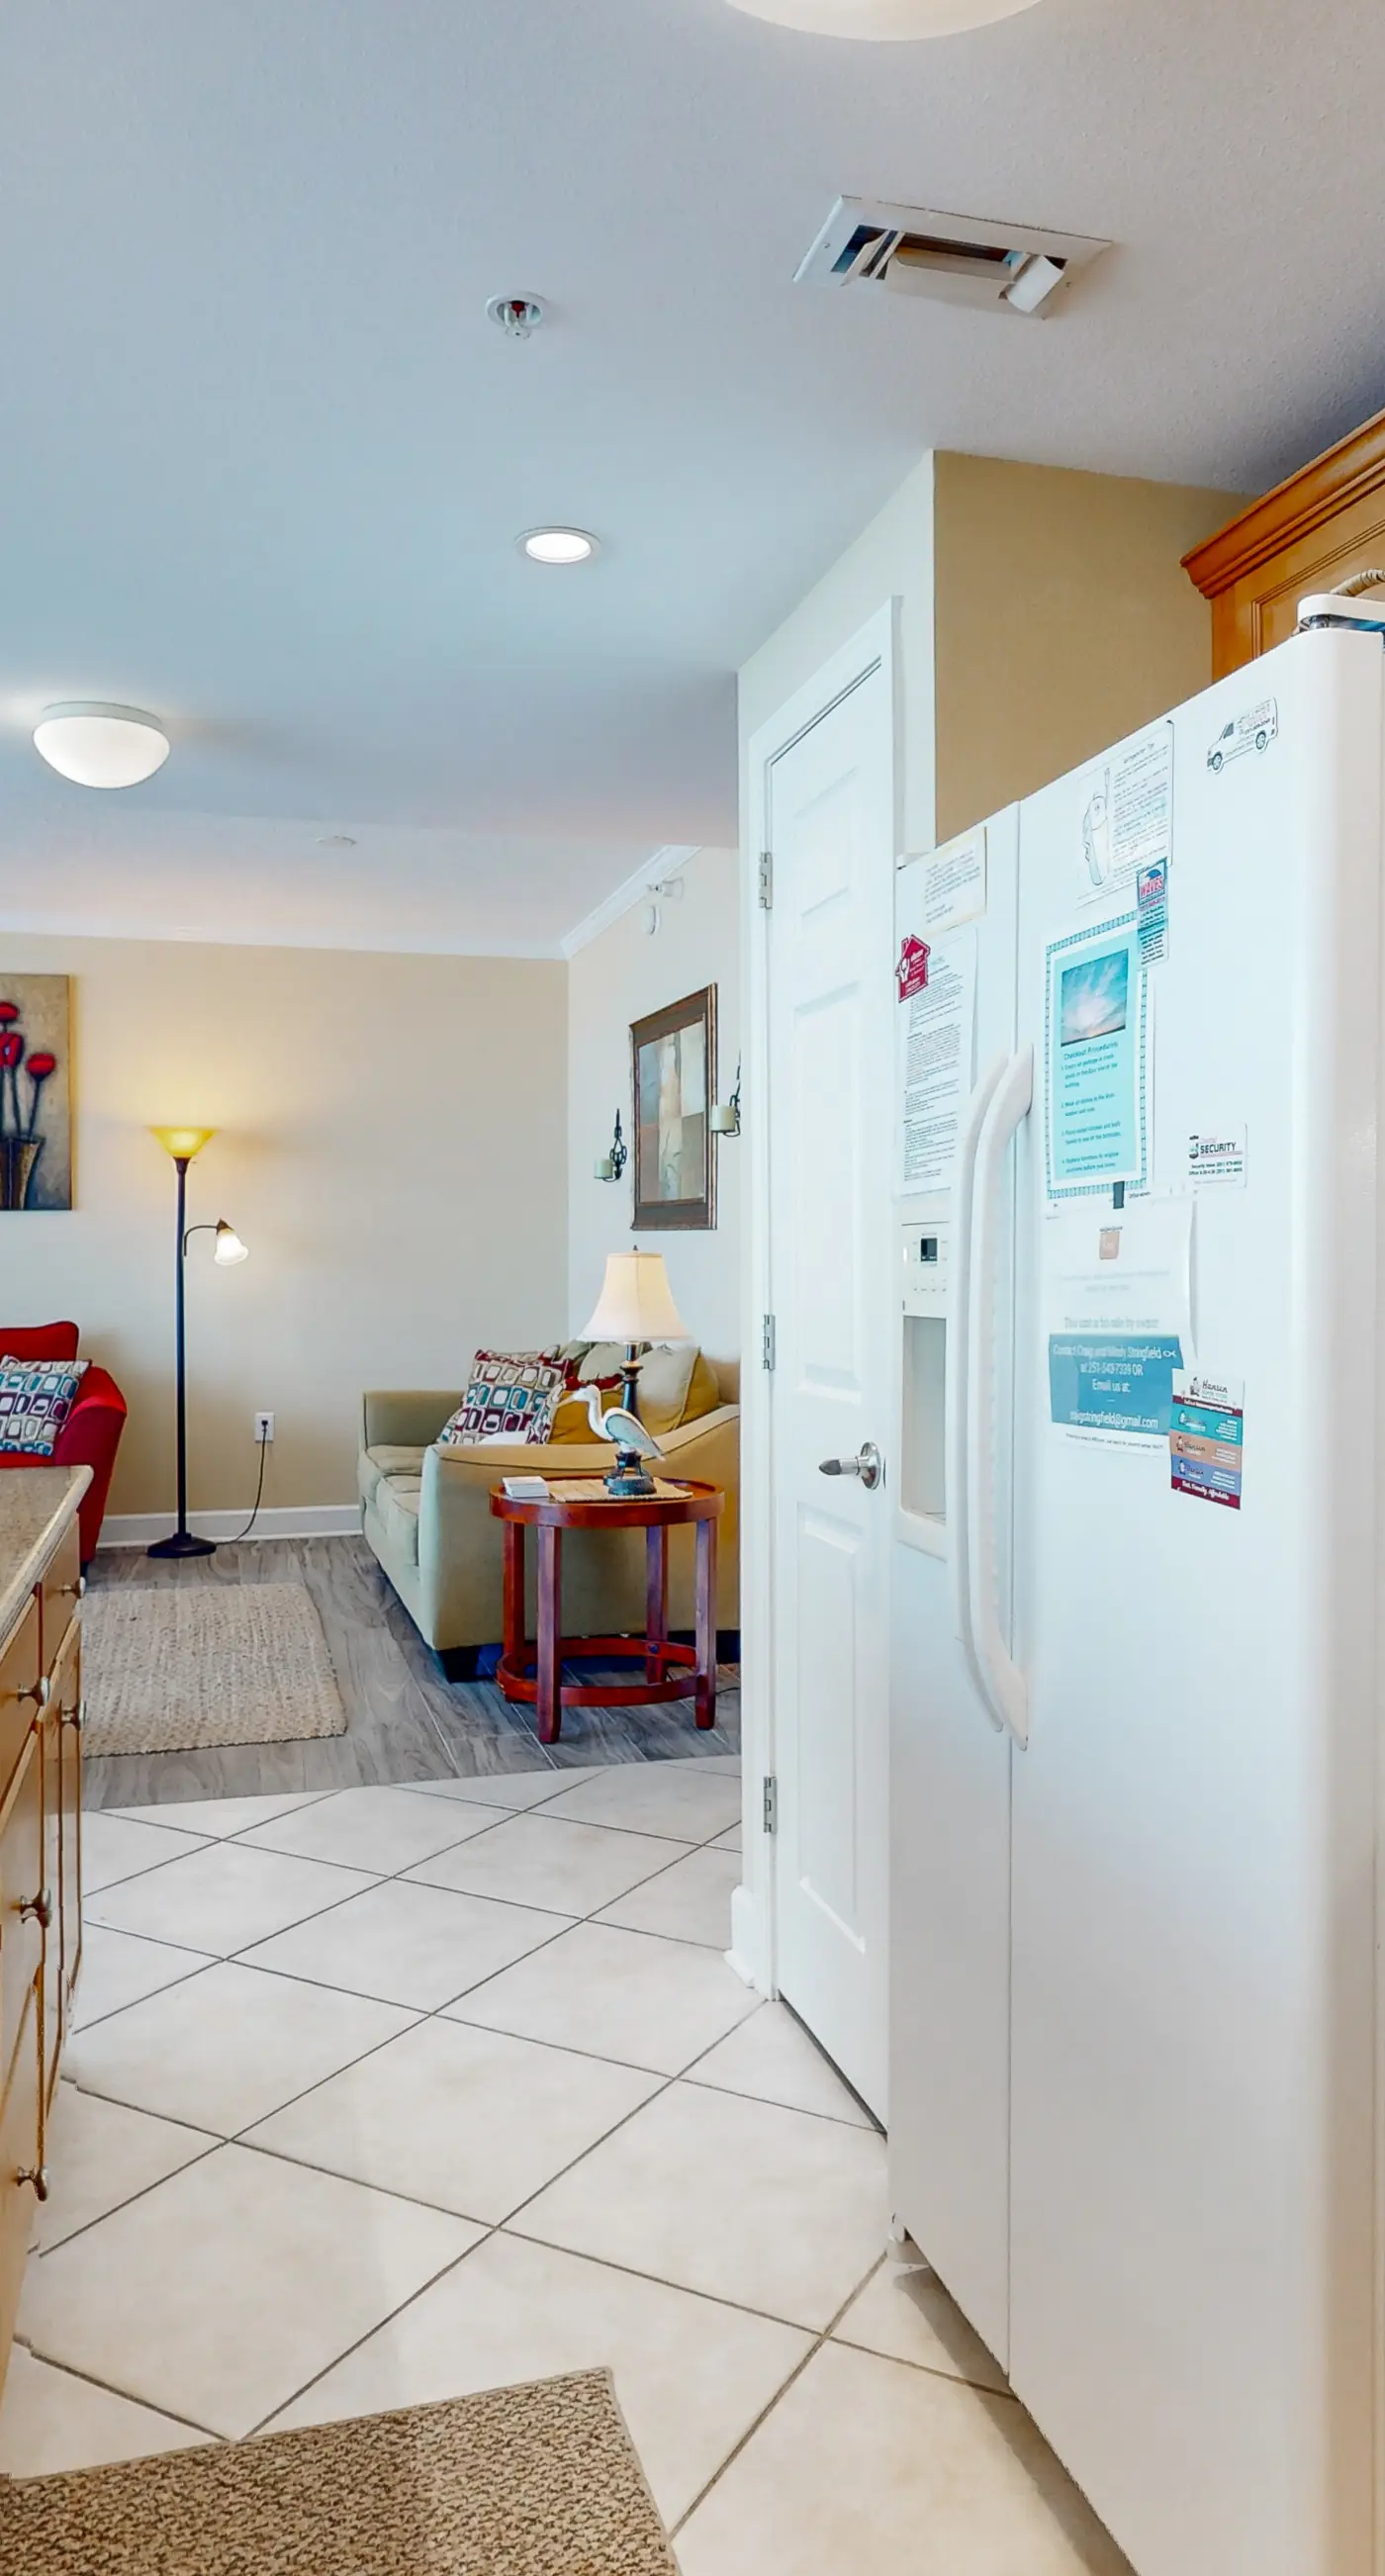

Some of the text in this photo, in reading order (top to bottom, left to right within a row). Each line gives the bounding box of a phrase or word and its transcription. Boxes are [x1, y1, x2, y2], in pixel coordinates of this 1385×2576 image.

[1140, 877, 1163, 897] WAVES
[1200, 1142, 1237, 1154] SECURITY
[1133, 1363, 1144, 1376] OR
[1112, 1381, 1121, 1392] us
[1202, 1378, 1228, 1393] Hansen
